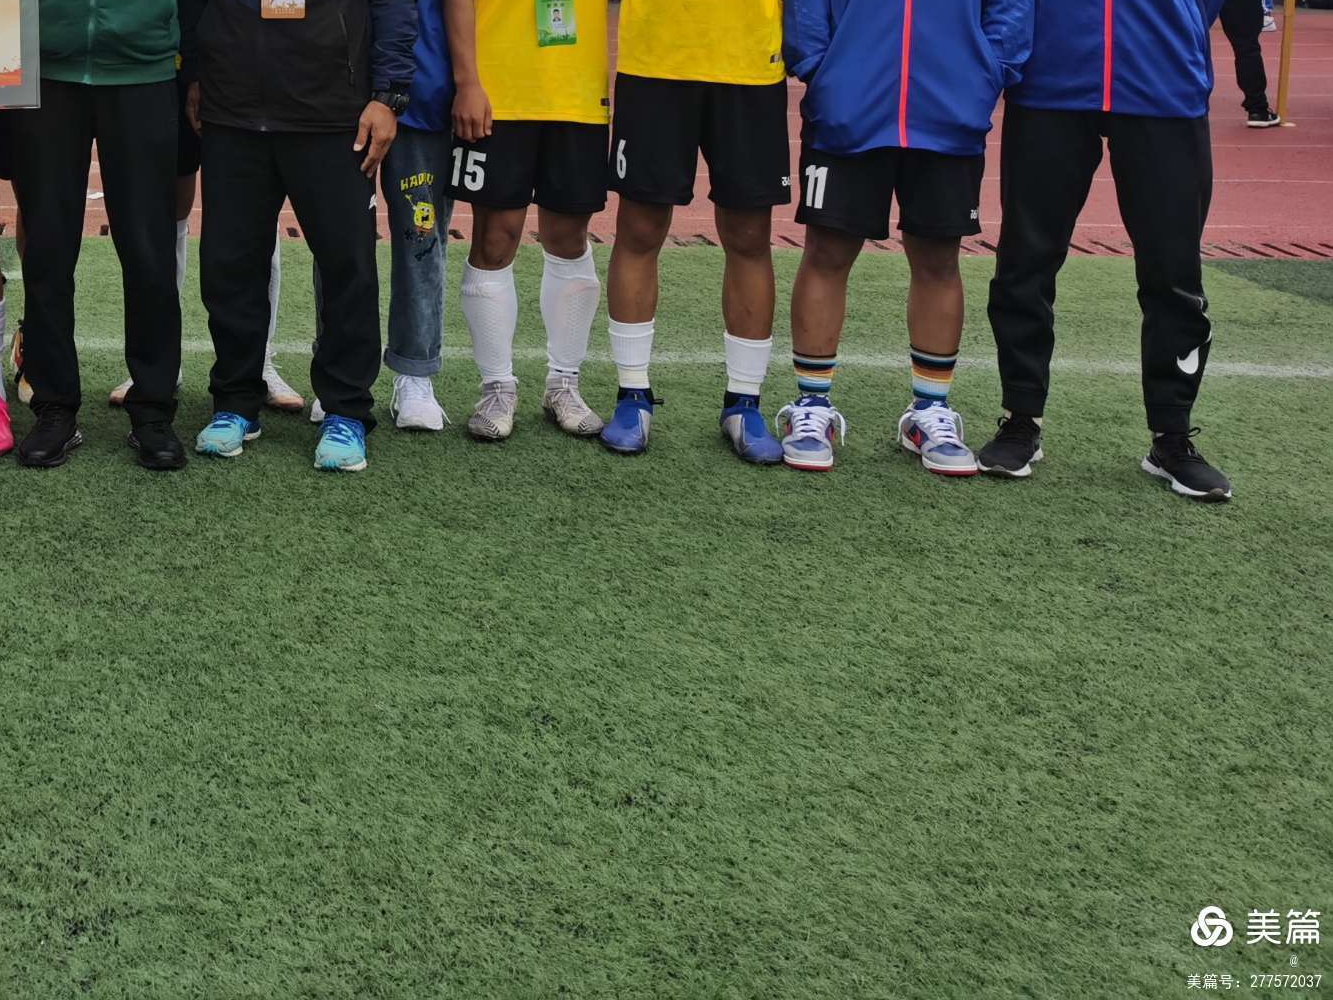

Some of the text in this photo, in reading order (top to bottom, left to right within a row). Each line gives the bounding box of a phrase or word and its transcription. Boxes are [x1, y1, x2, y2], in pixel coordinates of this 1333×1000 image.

[451, 146, 487, 192] 15
[616, 138, 627, 180] 6
[805, 164, 827, 210] 11
